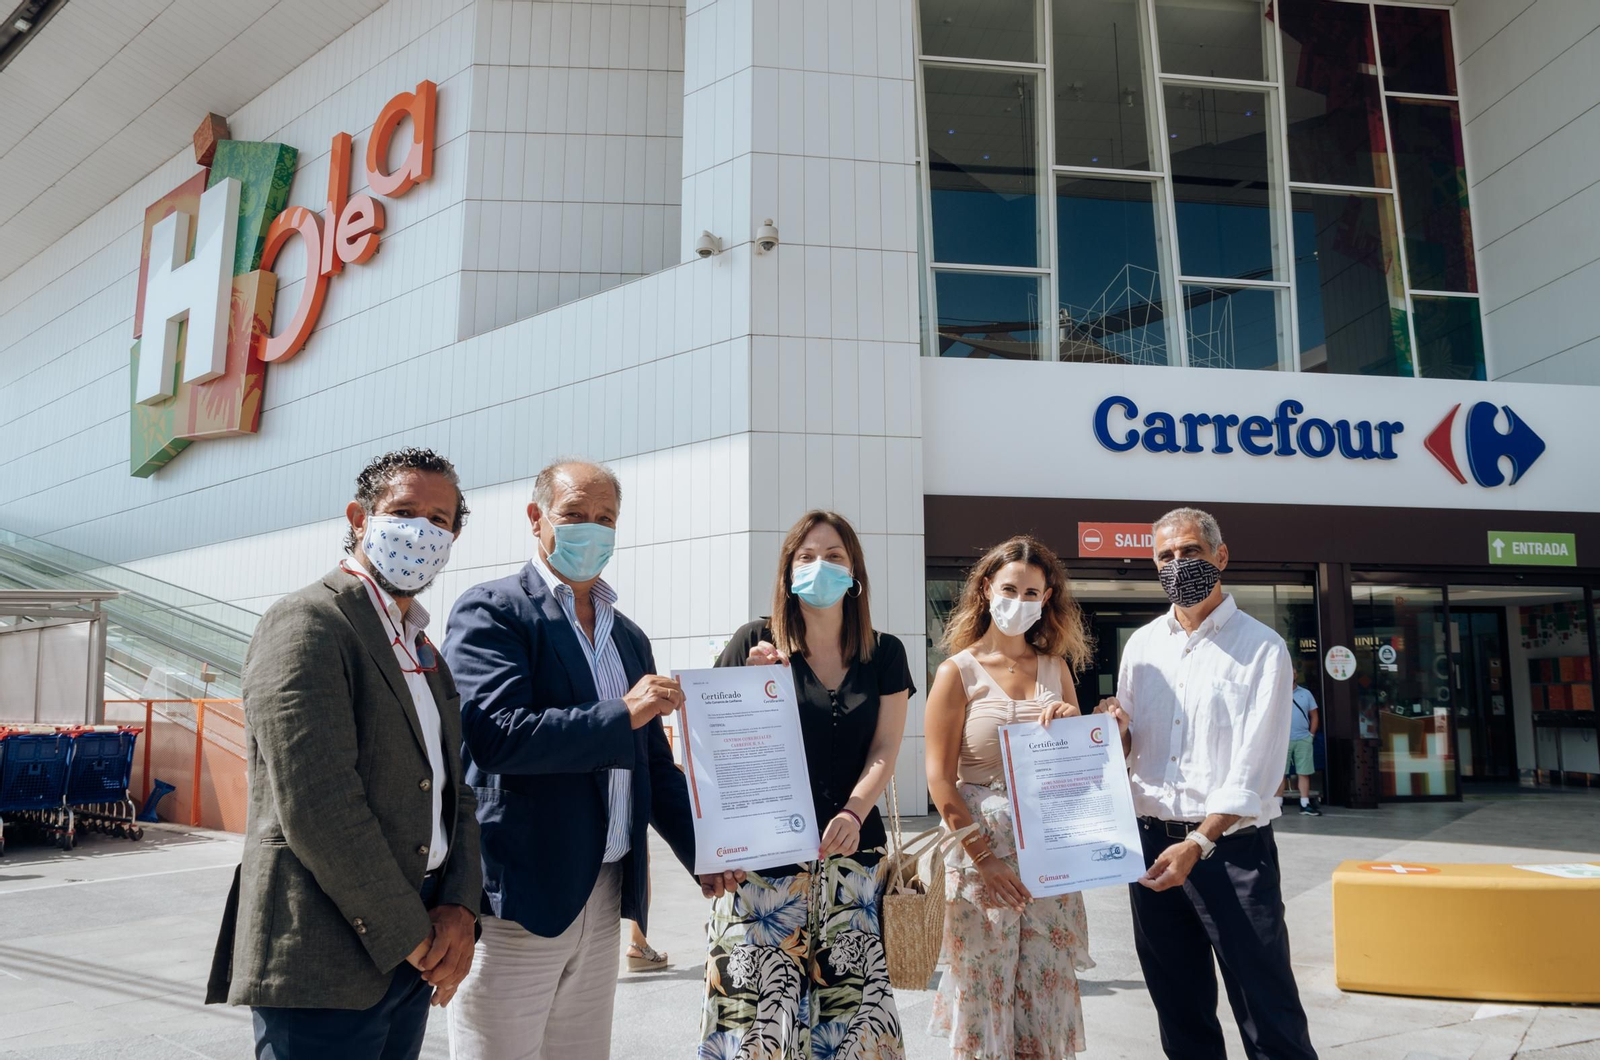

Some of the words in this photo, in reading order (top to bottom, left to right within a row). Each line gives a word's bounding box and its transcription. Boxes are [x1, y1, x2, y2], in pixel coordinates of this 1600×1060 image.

[1093, 395, 1404, 460] Carrefour
[1114, 533, 1153, 548] SALID
[1512, 541, 1569, 556] ENTRADA
[701, 690, 742, 701] Certificado
[1028, 738, 1069, 749] Certificado
[716, 845, 748, 857] Cámaras
[1039, 872, 1070, 884] Cámaras
